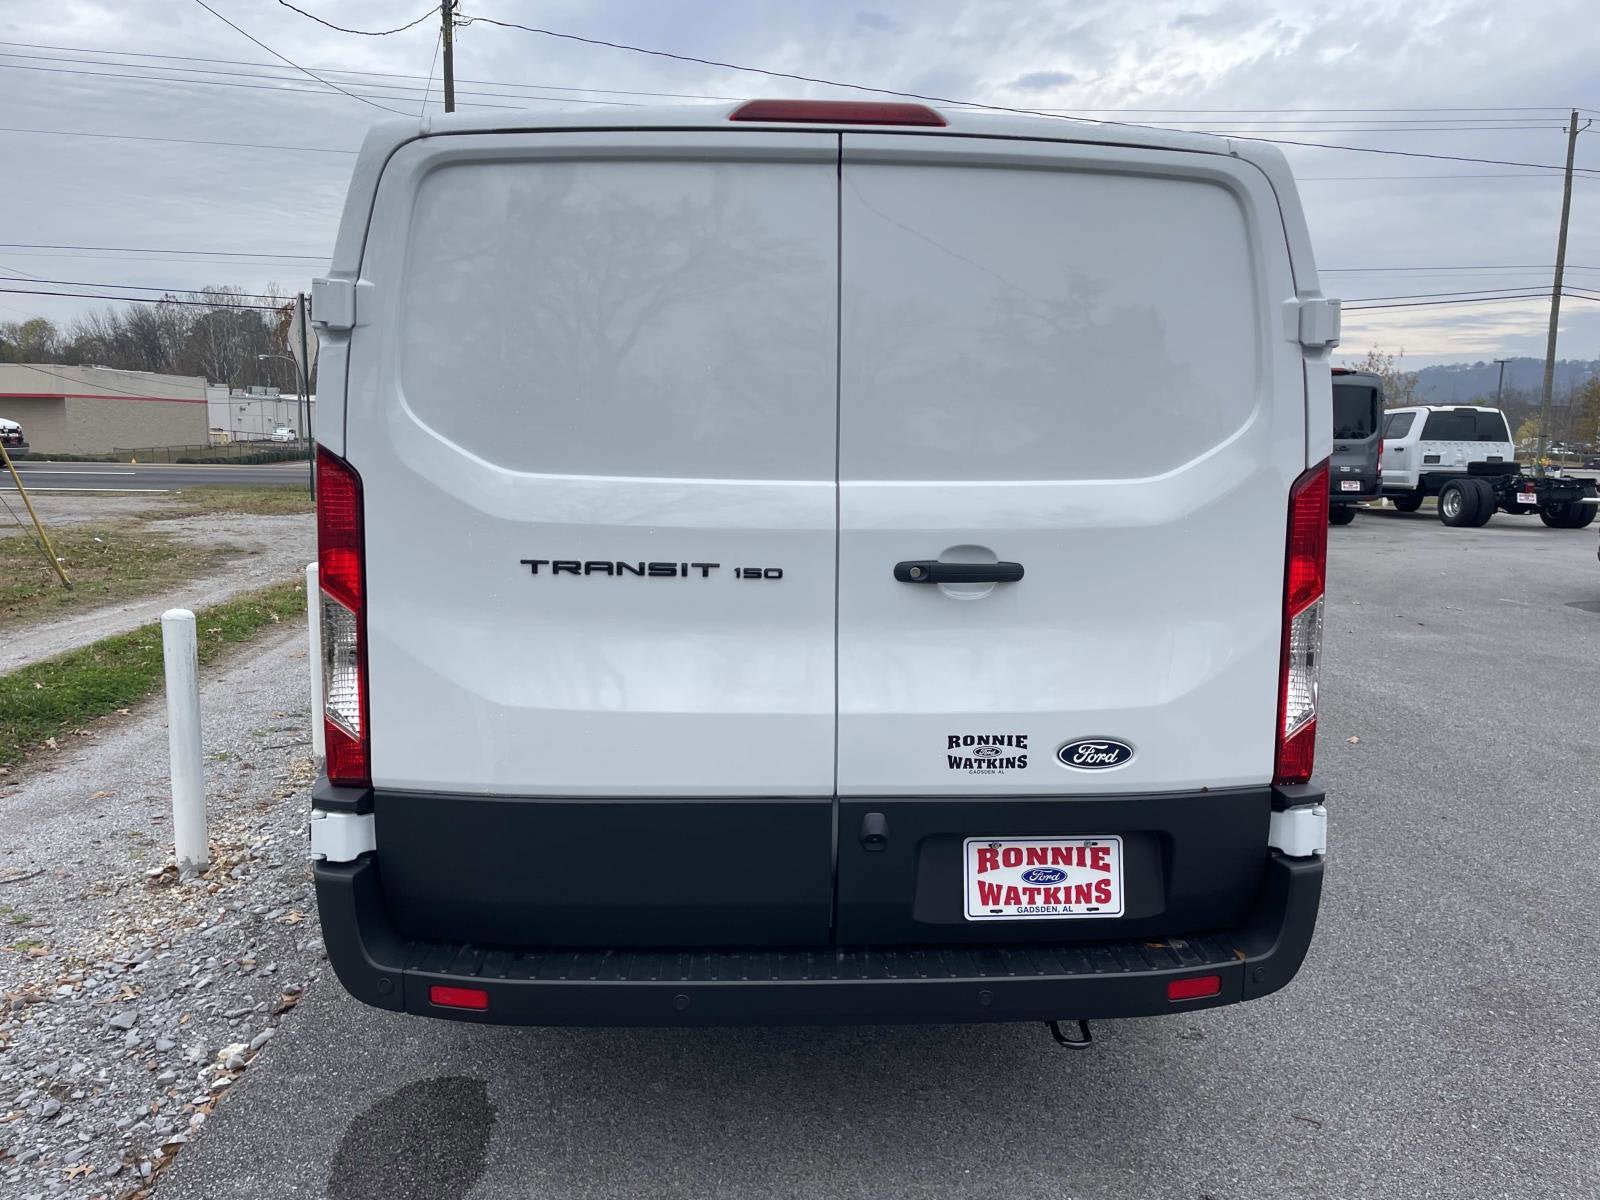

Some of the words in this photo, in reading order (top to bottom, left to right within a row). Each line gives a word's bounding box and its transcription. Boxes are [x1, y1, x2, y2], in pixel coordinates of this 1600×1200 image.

[520, 559, 720, 578] TRANSIT
[734, 567, 783, 579] 150
[947, 735, 1028, 749] RONNIE
[947, 754, 1028, 769] WATKINS
[1073, 744, 1119, 763] Ford
[977, 846, 1111, 874] RONNIE
[1029, 870, 1061, 881] Ford
[977, 878, 1112, 907] WATKINS
[1016, 905, 1060, 914] GADSDEN,
